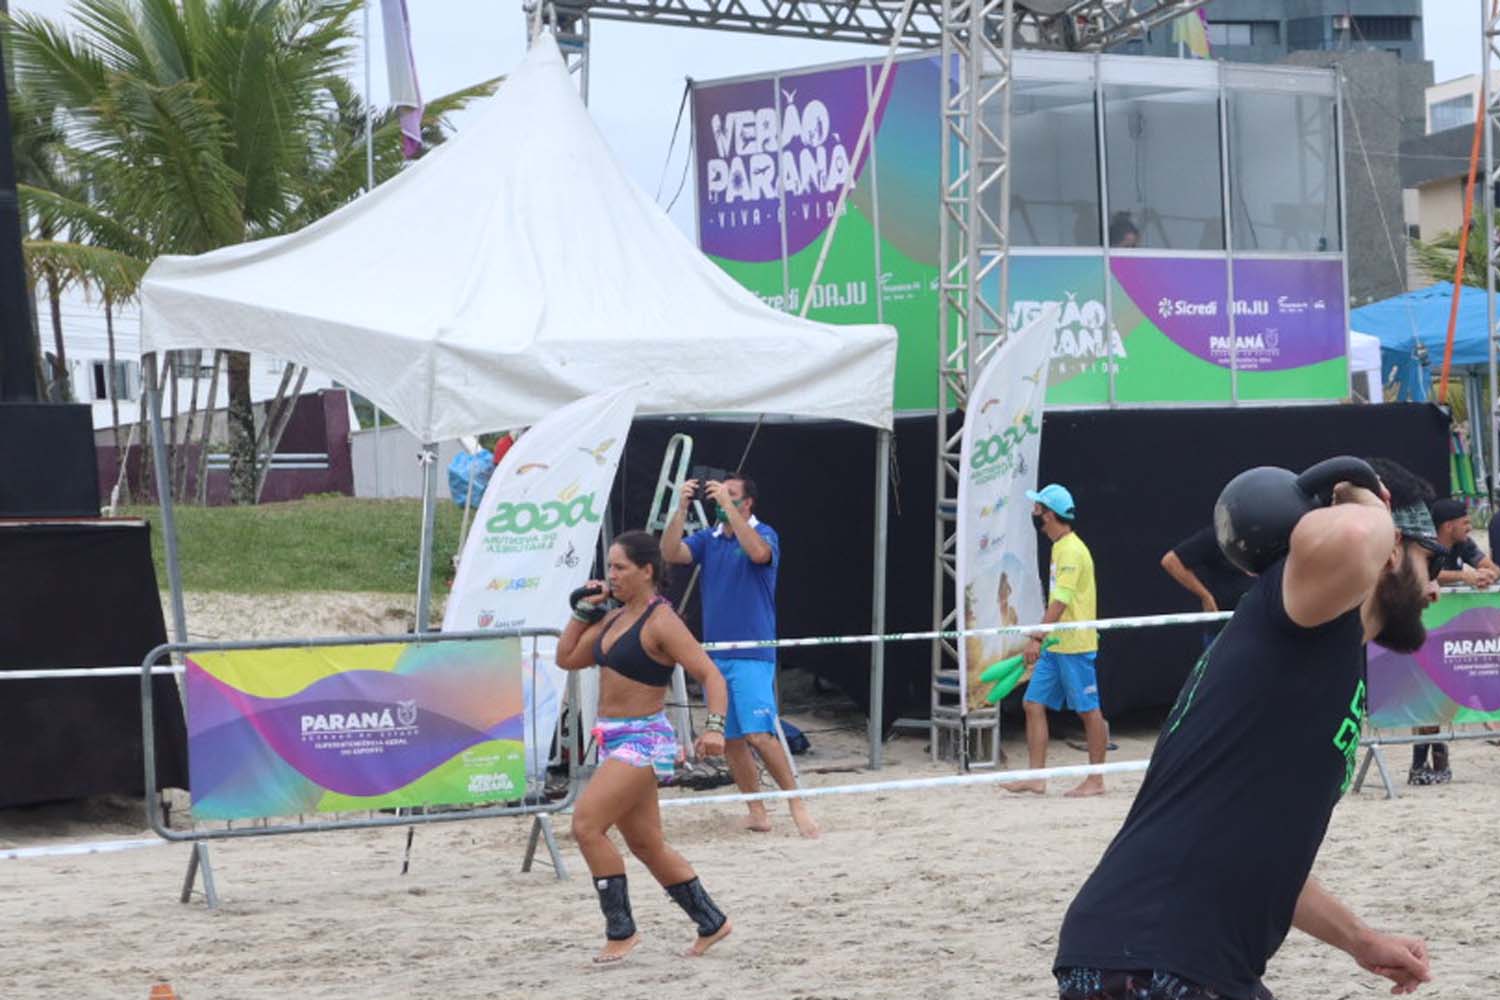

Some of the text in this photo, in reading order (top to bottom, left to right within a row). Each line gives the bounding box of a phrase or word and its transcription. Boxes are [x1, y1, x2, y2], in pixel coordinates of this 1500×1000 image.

[710, 89, 830, 157] VERÃO
[718, 207, 761, 228] VIVA
[811, 281, 867, 308] DAJU
[1175, 299, 1217, 316] Sicredi
[301, 707, 395, 732] PARANÁ
